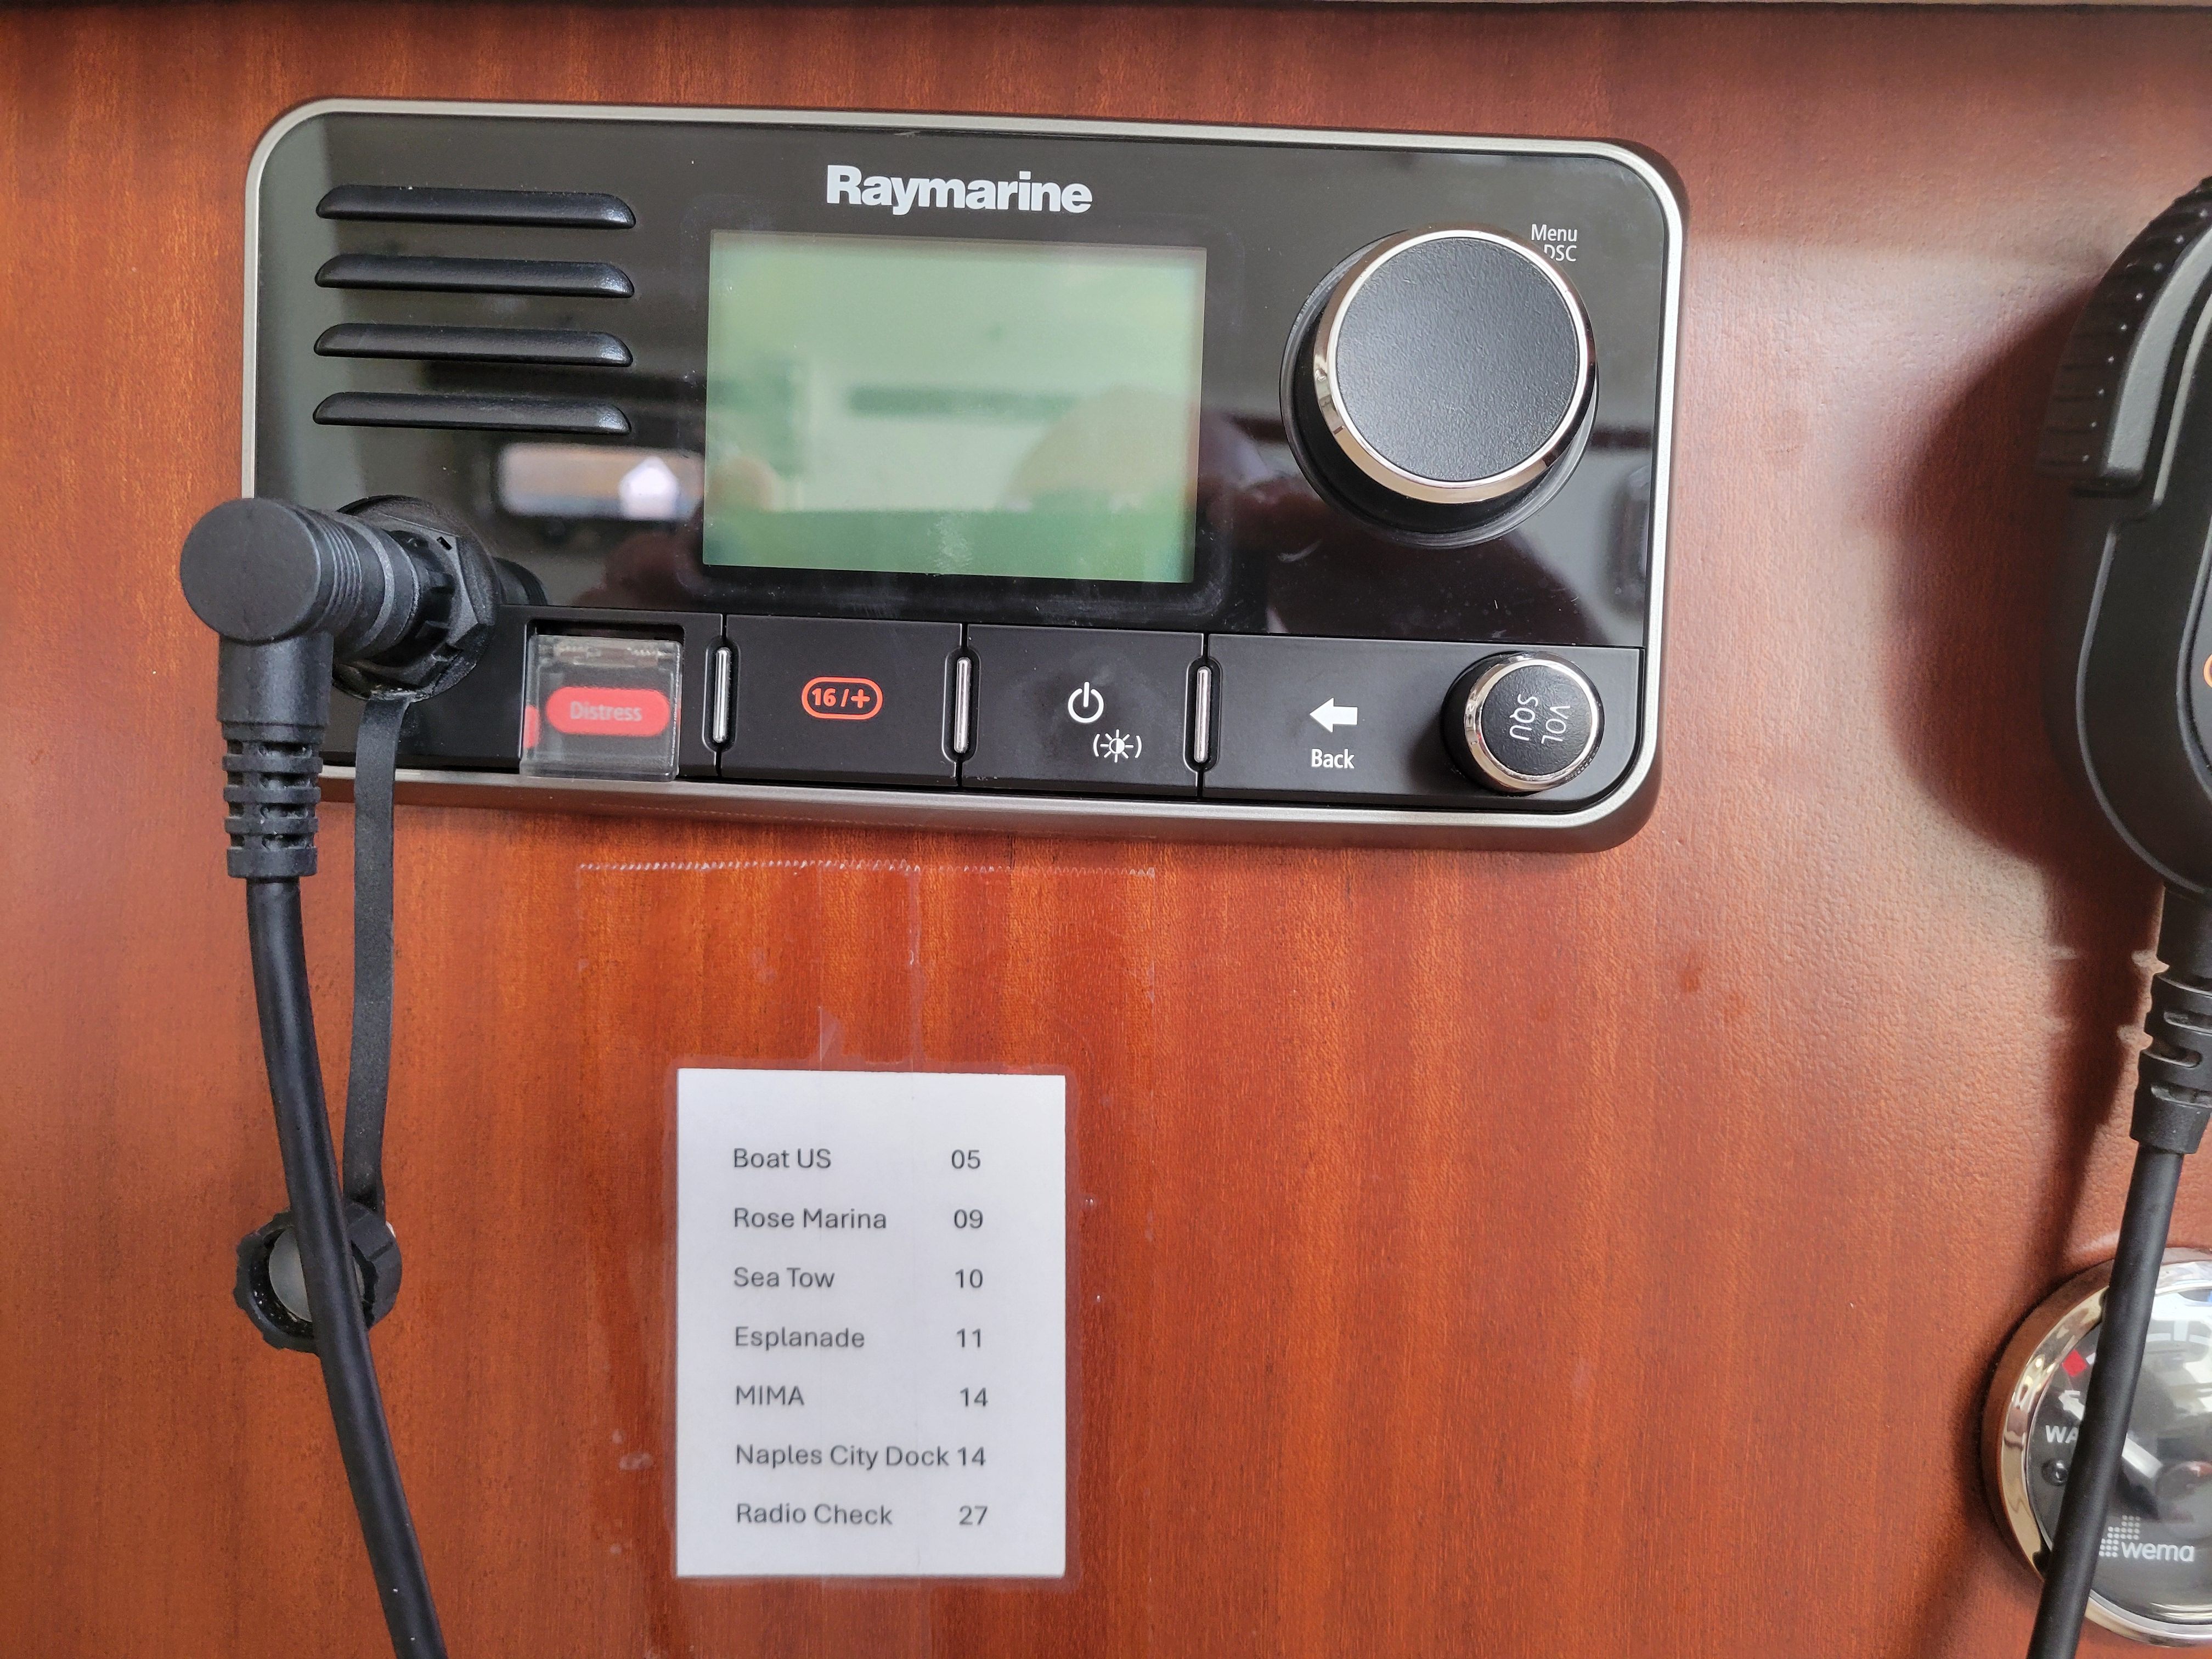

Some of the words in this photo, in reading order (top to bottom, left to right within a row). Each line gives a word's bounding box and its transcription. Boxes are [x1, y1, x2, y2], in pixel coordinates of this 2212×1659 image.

[827, 165, 1093, 215] Raymarine
[1531, 224, 1578, 242] Menu
[569, 701, 642, 721] Distress
[1509, 693, 1538, 741] SQU
[1541, 706, 1571, 744] VOL
[1311, 749, 1355, 769] Back
[733, 1148, 789, 1169] Boat
[797, 1149, 832, 1170] US
[951, 1149, 981, 1170] 05
[734, 1207, 794, 1228] Rose
[803, 1208, 887, 1229] Marina
[953, 1209, 983, 1229] 09
[733, 1267, 780, 1288] Sea
[787, 1267, 835, 1288] Tow
[956, 1268, 983, 1289] 10
[735, 1326, 865, 1351] Esplanade
[956, 1328, 982, 1348] 11
[736, 1385, 805, 1406] MIMA
[960, 1387, 988, 1407] 14
[736, 1444, 822, 1469] Naples
[830, 1444, 878, 1470] City
[887, 1446, 950, 1466] Dock
[957, 1447, 986, 1466] 14
[737, 1503, 806, 1523] Radio
[814, 1503, 893, 1525] Check
[959, 1505, 988, 1526] 27
[2121, 1541, 2194, 1561] wema
